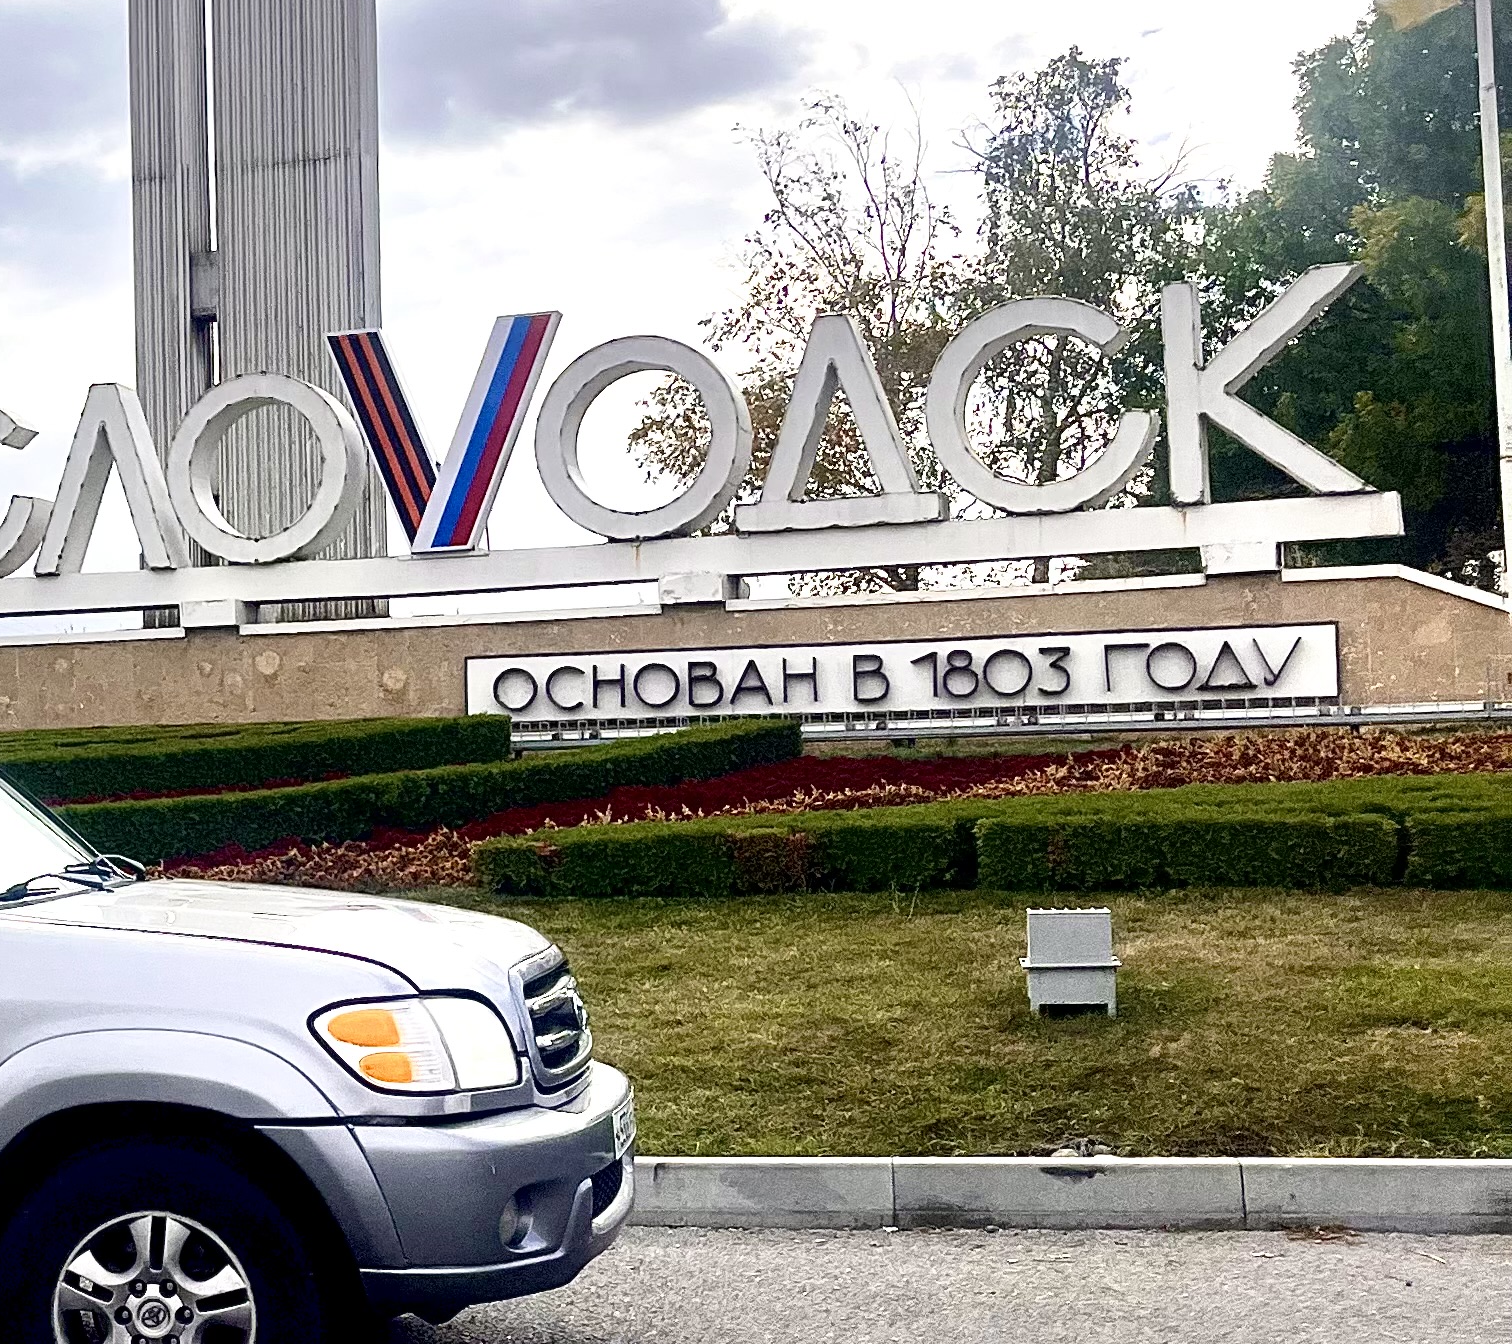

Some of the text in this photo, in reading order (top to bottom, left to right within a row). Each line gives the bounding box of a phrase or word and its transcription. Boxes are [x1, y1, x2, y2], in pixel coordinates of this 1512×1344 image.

[492, 636, 1302, 712] ОСНОВАН В 1803 ГОДУ
